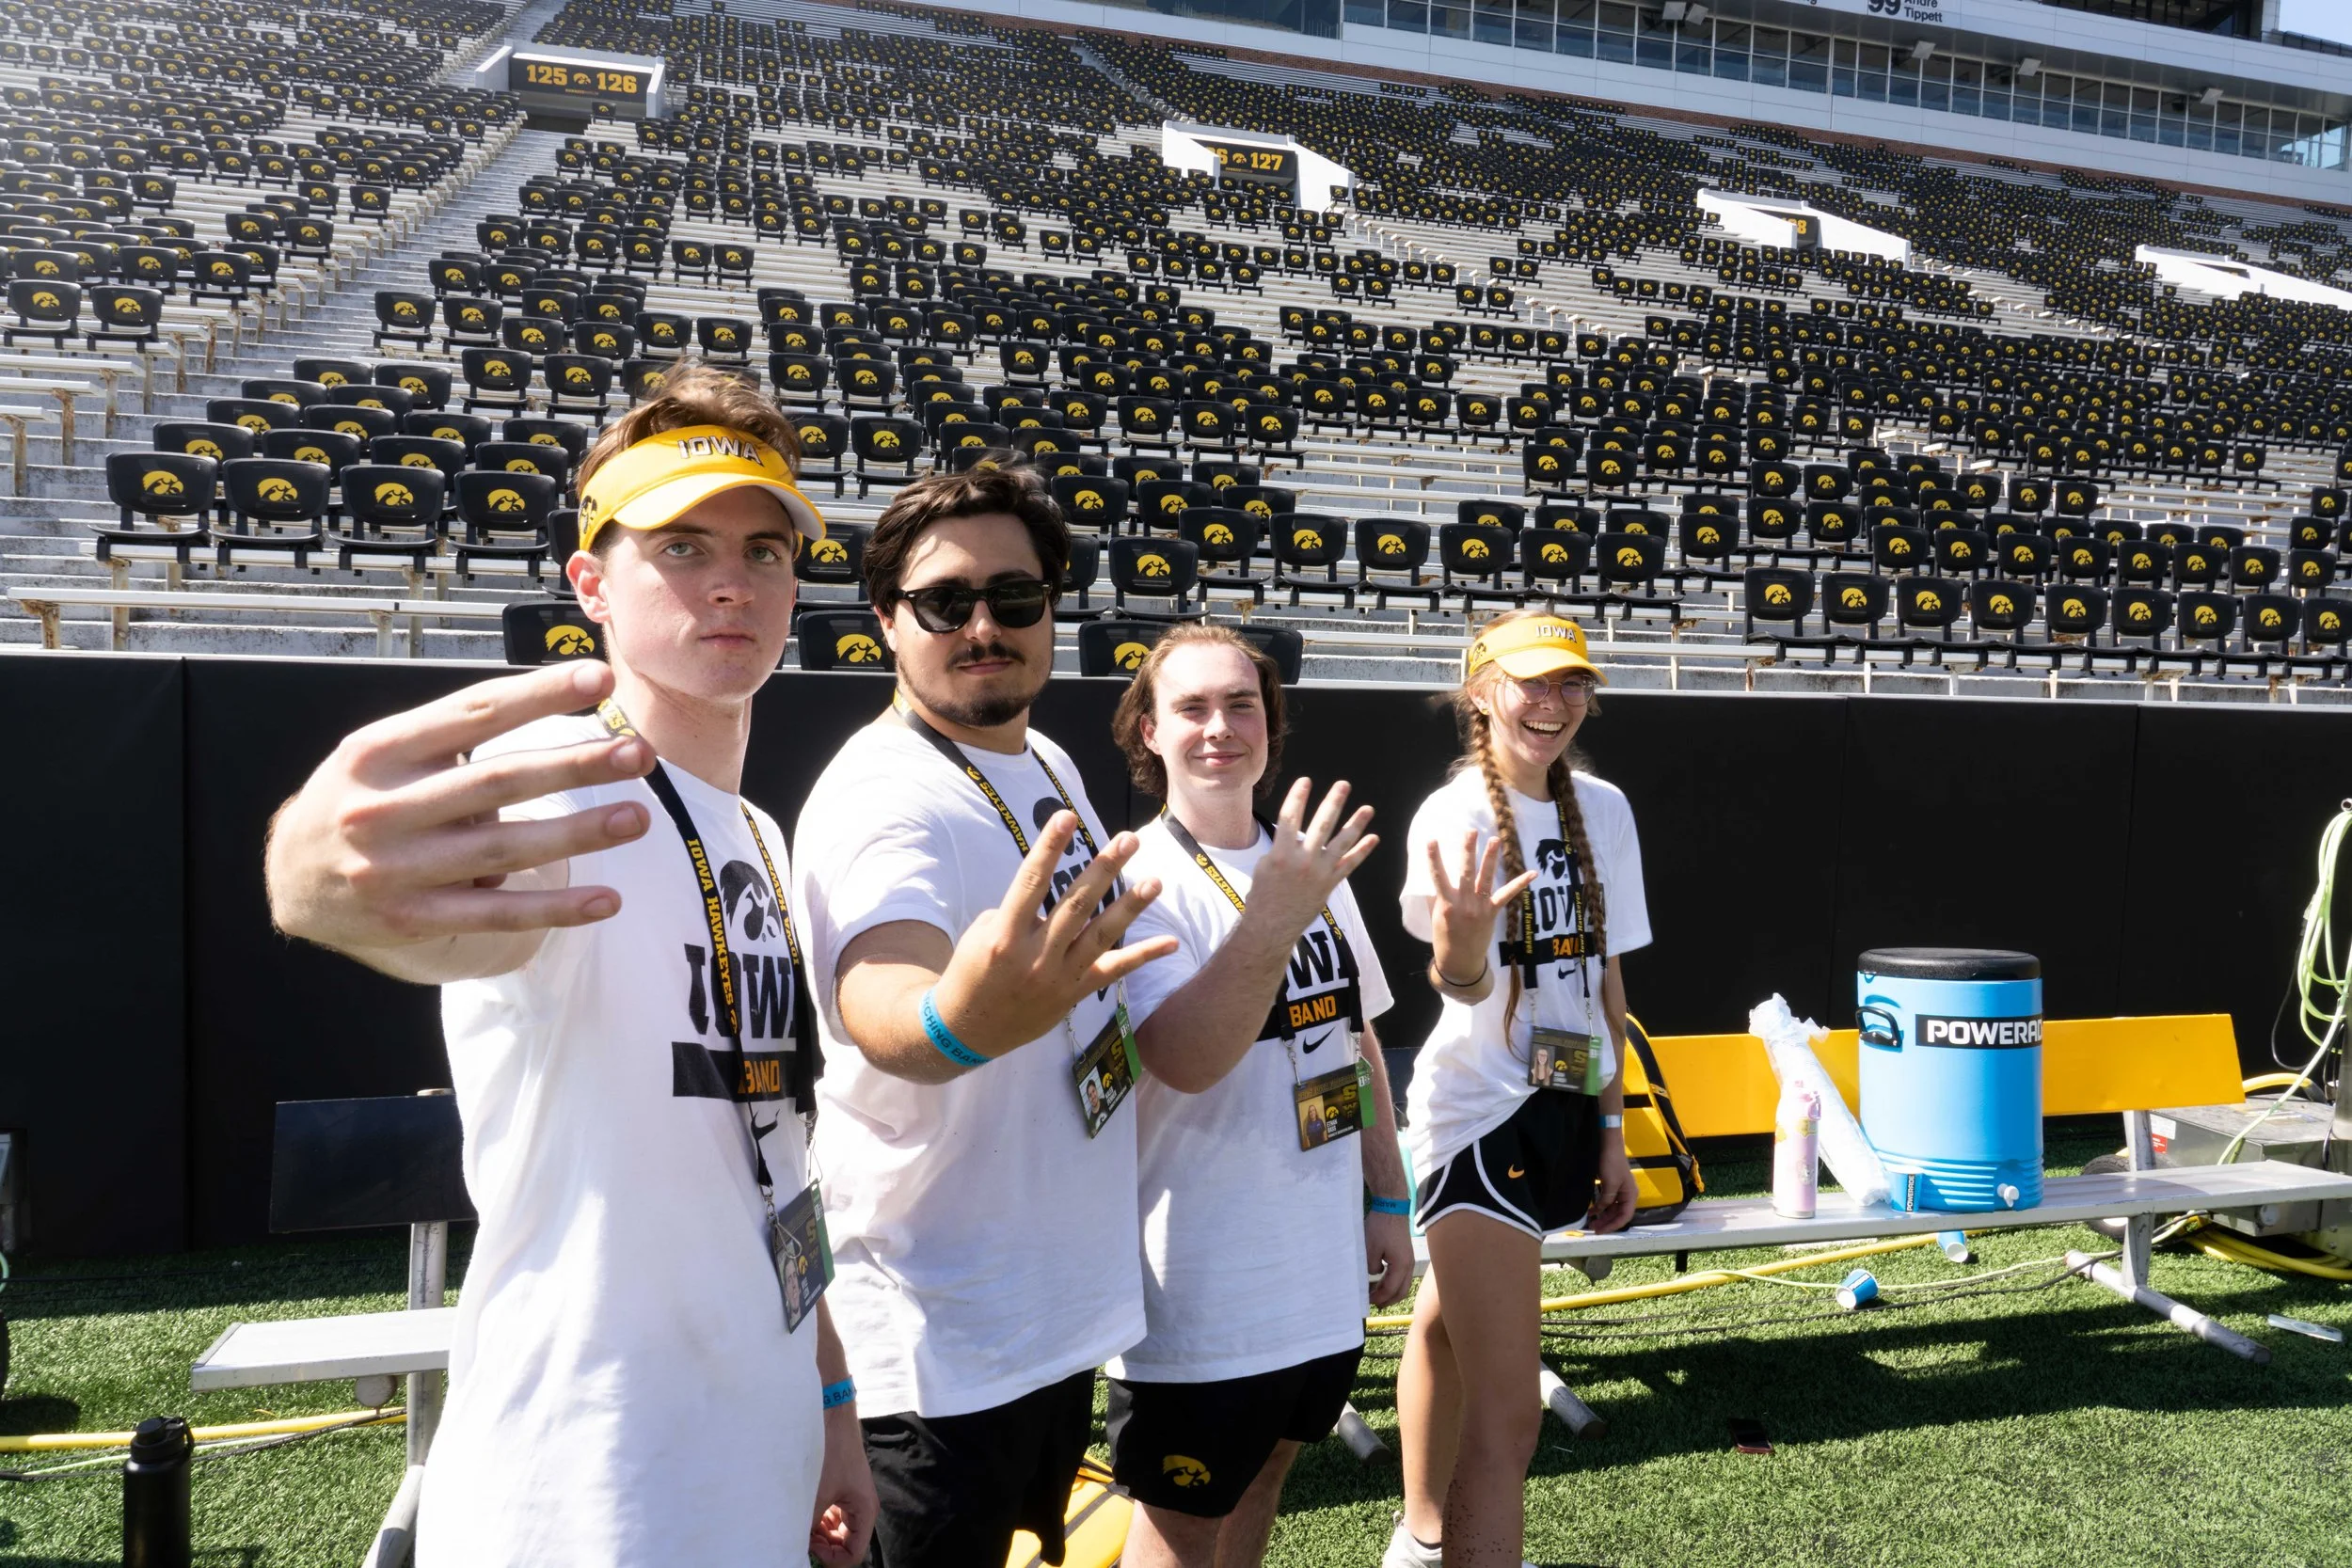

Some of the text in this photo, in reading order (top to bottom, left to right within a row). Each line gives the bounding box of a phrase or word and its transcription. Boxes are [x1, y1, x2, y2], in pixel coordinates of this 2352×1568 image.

[1904, 7, 1943, 23] Tippett
[527, 64, 637, 94] 125 126
[1250, 151, 1282, 171] 127
[677, 436, 765, 467] IOWA
[1535, 625, 1577, 643] IOWA
[979, 782, 1028, 852] HAWKEYES
[687, 838, 735, 1006] IOWA HAWKEYES
[684, 942, 798, 1039] IOW
[1289, 995, 1337, 1028] BAND
[1927, 1019, 2043, 1046] POWERAD
[1906, 1175, 1915, 1212] POWERADE
[833, 1386, 852, 1402] BAN
